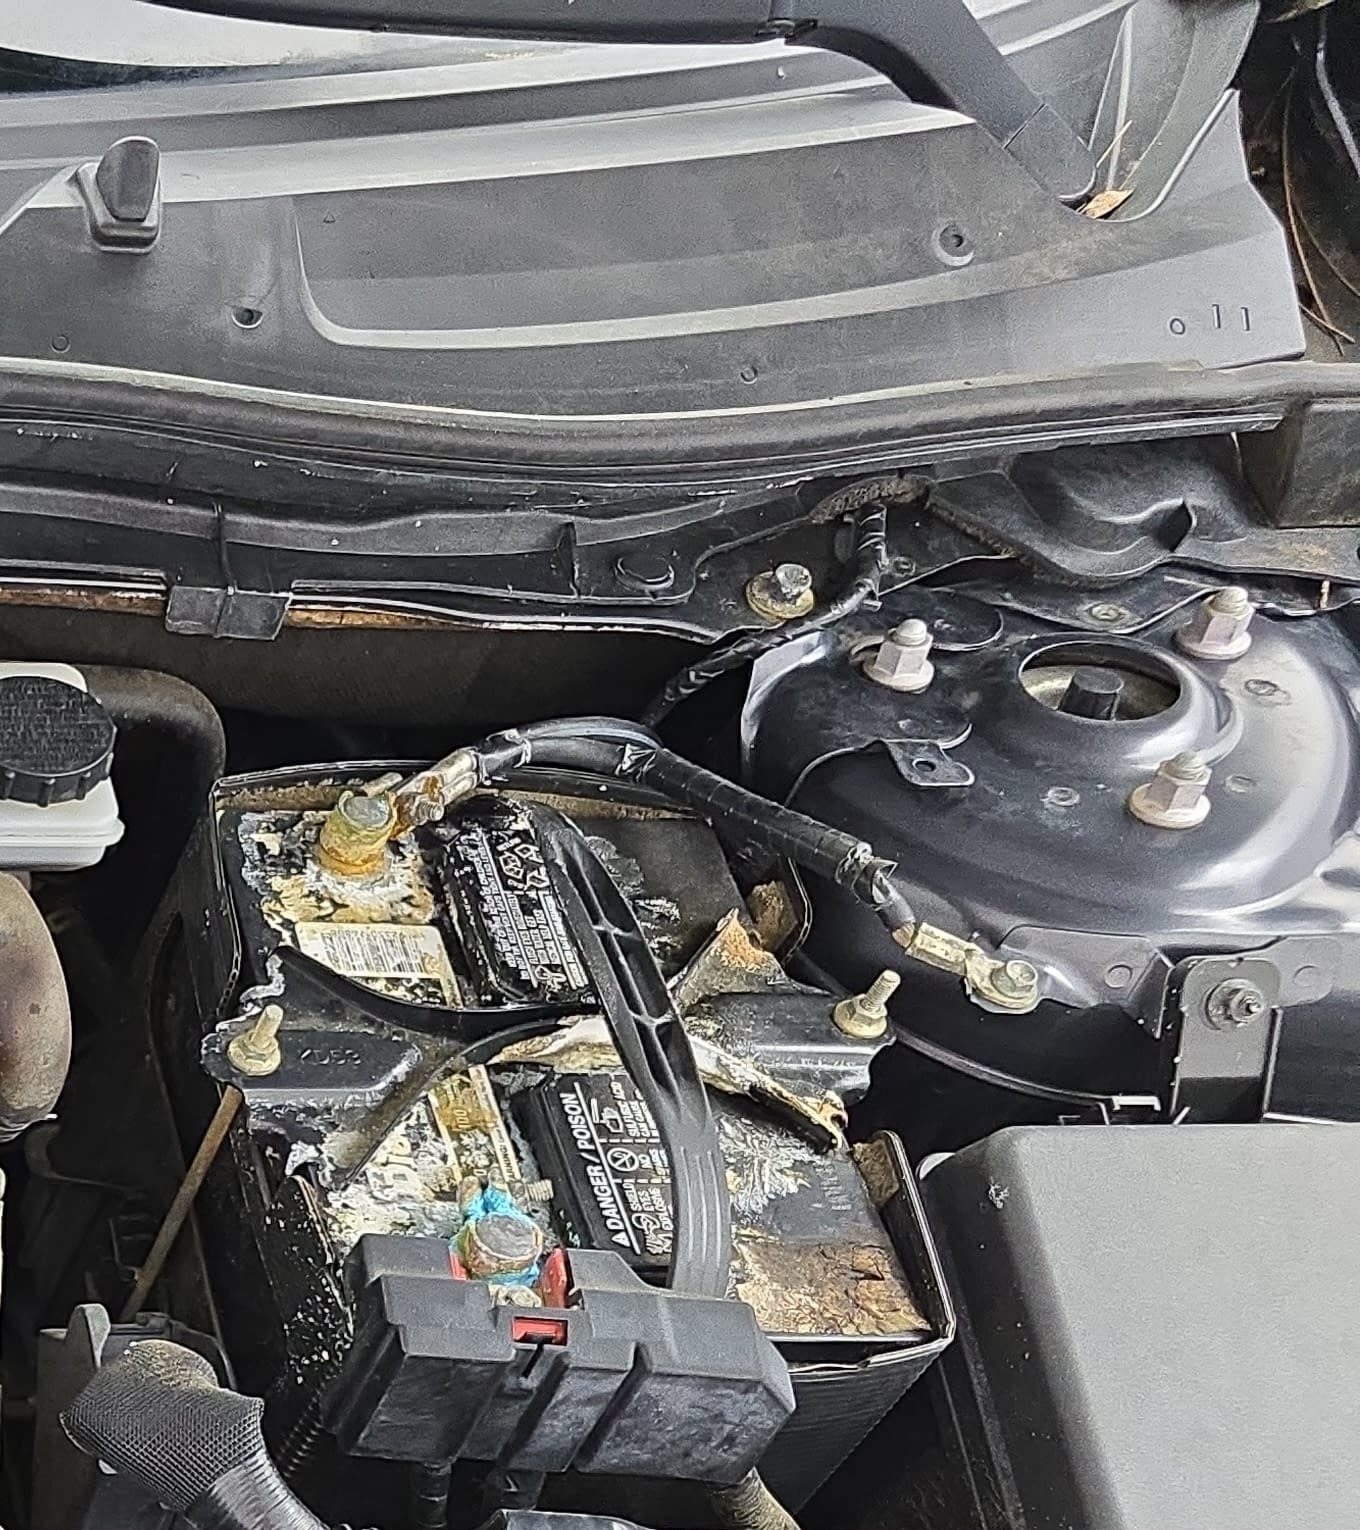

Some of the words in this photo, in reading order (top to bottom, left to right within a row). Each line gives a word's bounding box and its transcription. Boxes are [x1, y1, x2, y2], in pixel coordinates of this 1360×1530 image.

[559, 1092, 595, 1149] POISON
[638, 1154, 652, 1168] NO
[585, 1164, 624, 1230] DANGER
[638, 1189, 654, 1211] EYES
